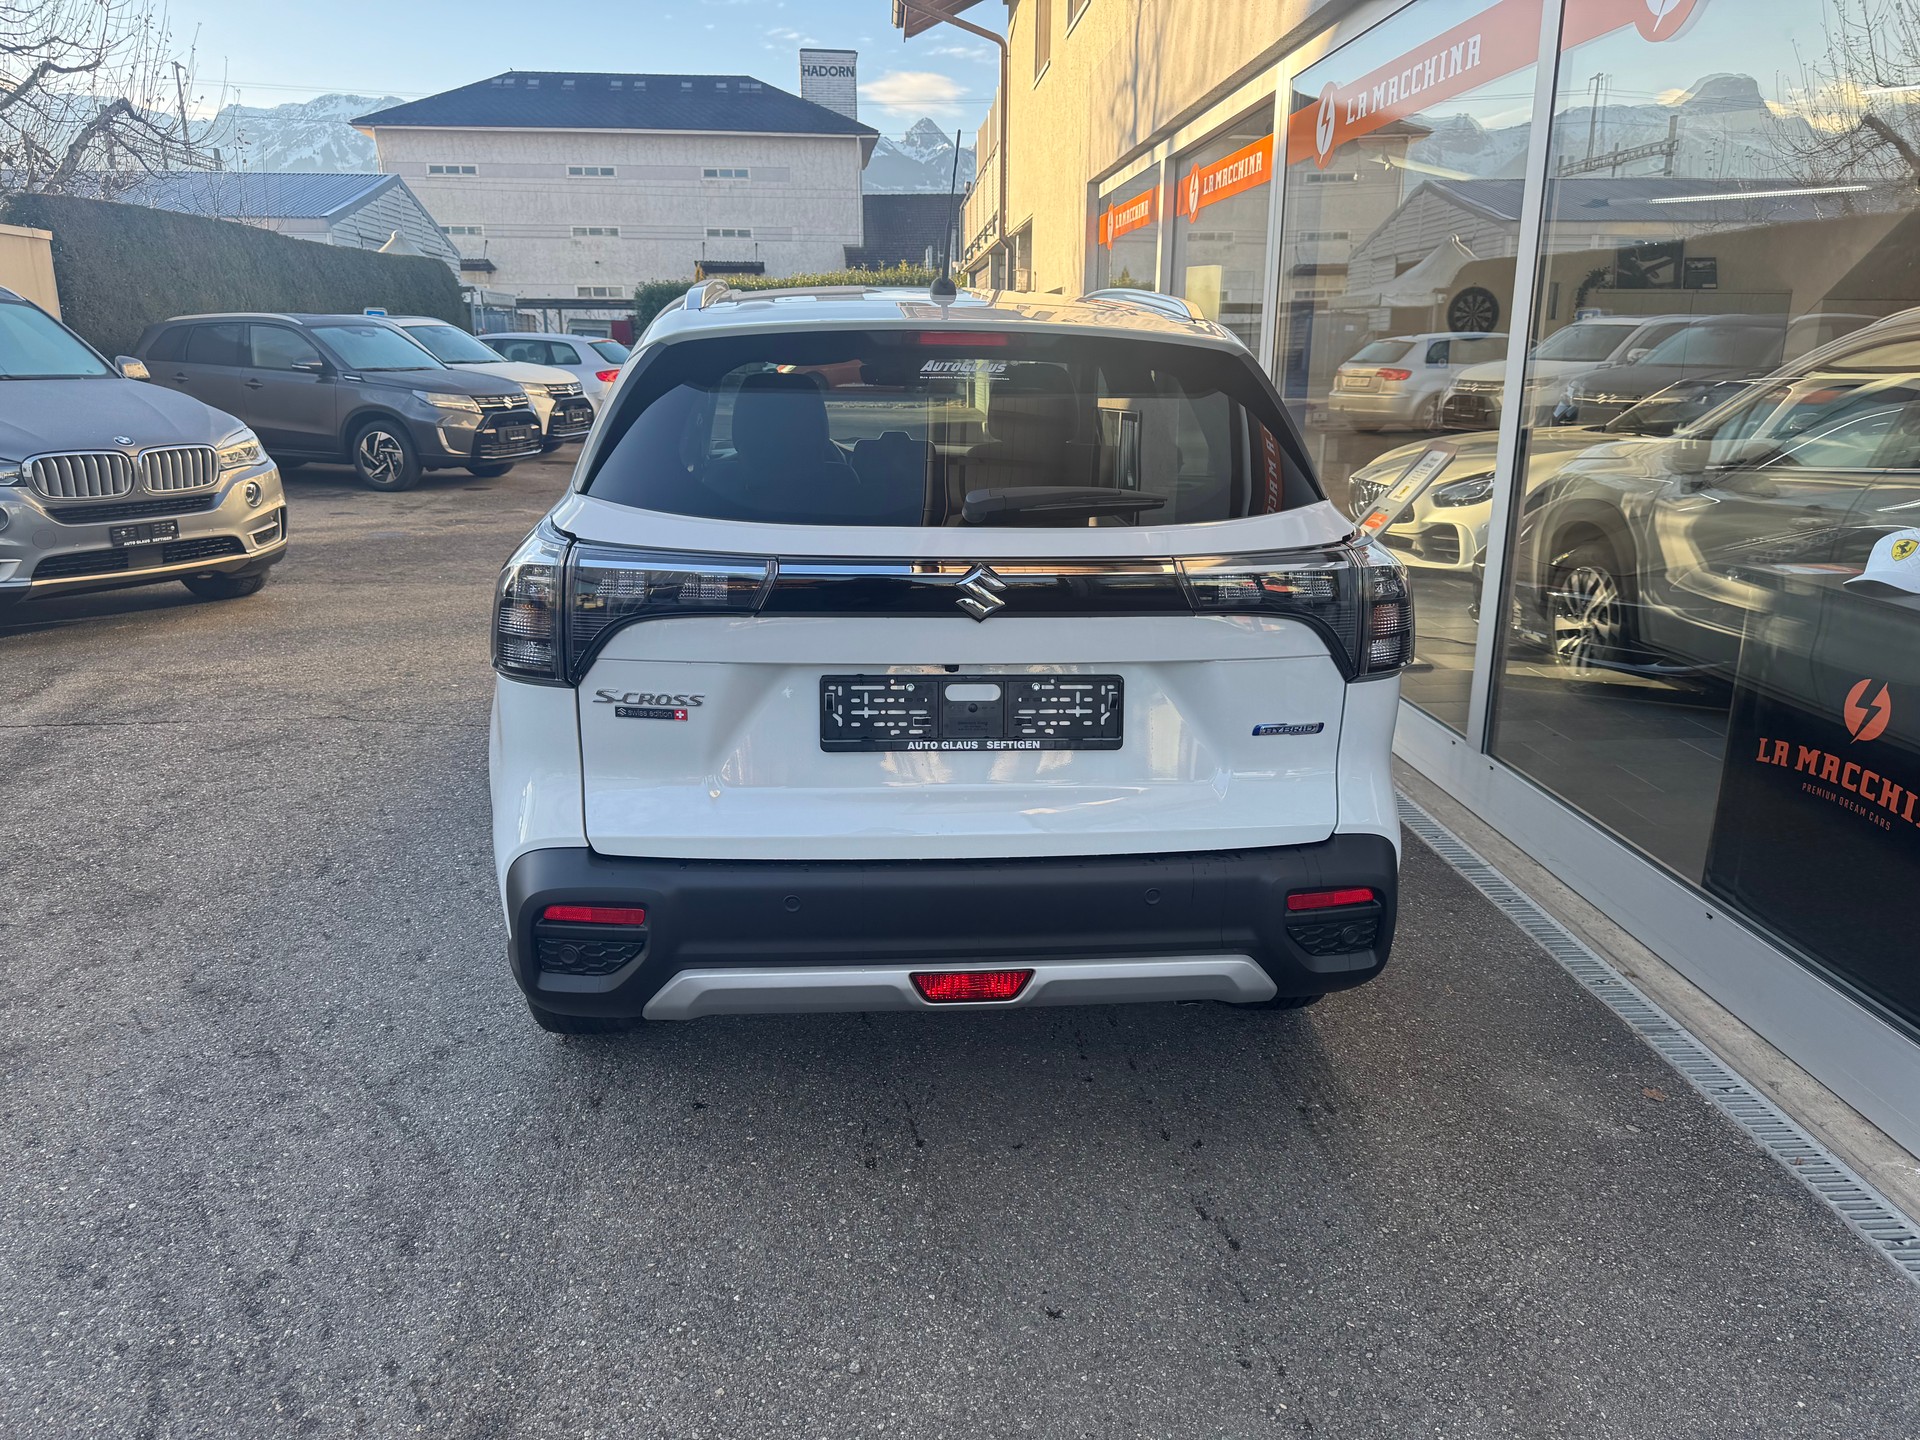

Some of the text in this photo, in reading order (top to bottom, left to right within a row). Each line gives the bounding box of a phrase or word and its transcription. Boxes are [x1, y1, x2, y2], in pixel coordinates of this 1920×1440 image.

[802, 65, 855, 77] HADORN
[1345, 33, 1482, 126] LA MACCHINA
[1203, 151, 1263, 195] LA MACCHINA
[907, 740, 1041, 750] AUTO GLAUS SEFTIGEN
[1264, 725, 1318, 734] HYBRID
[1755, 737, 1920, 829] LA MACCHI
[1801, 782, 1891, 831] PREMIUM DREAM CARS
